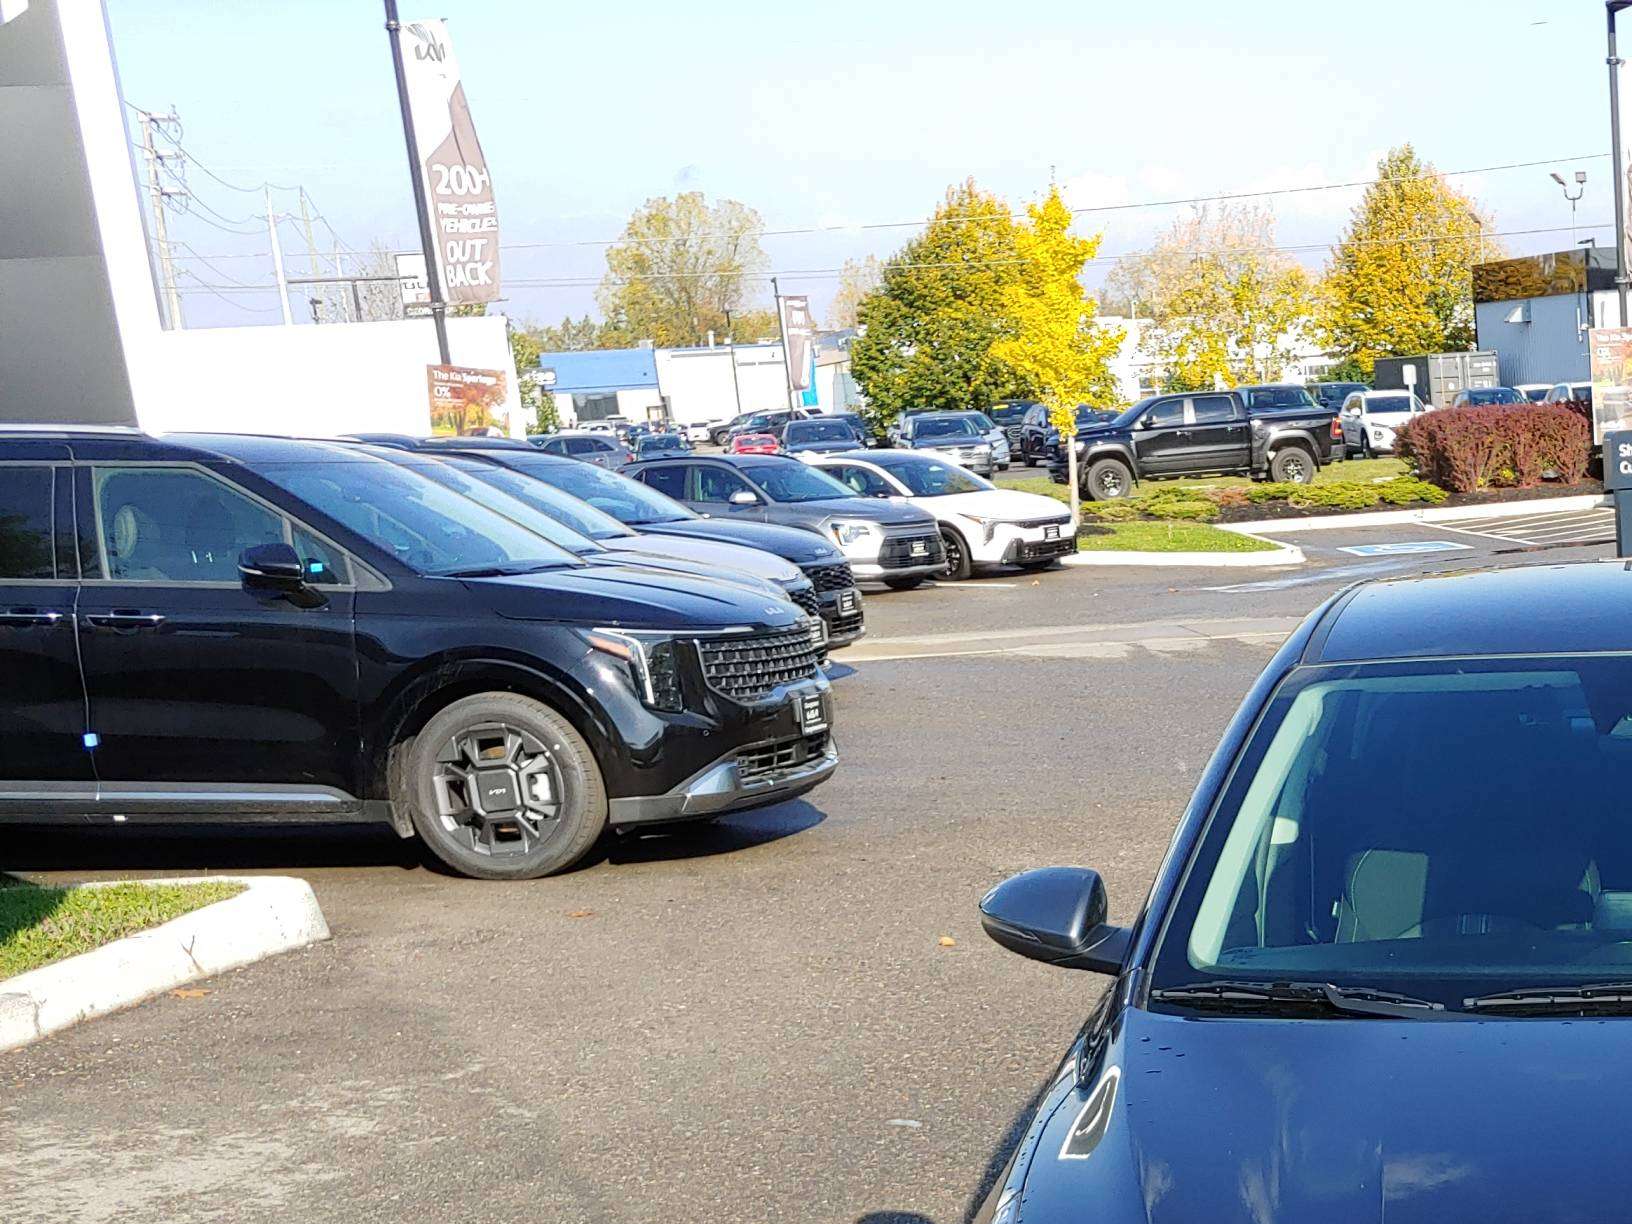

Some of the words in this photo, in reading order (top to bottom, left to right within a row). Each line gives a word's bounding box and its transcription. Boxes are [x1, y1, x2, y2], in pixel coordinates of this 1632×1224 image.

[446, 239, 488, 263] OUT
[446, 261, 493, 288] BACK
[432, 370, 449, 381] The
